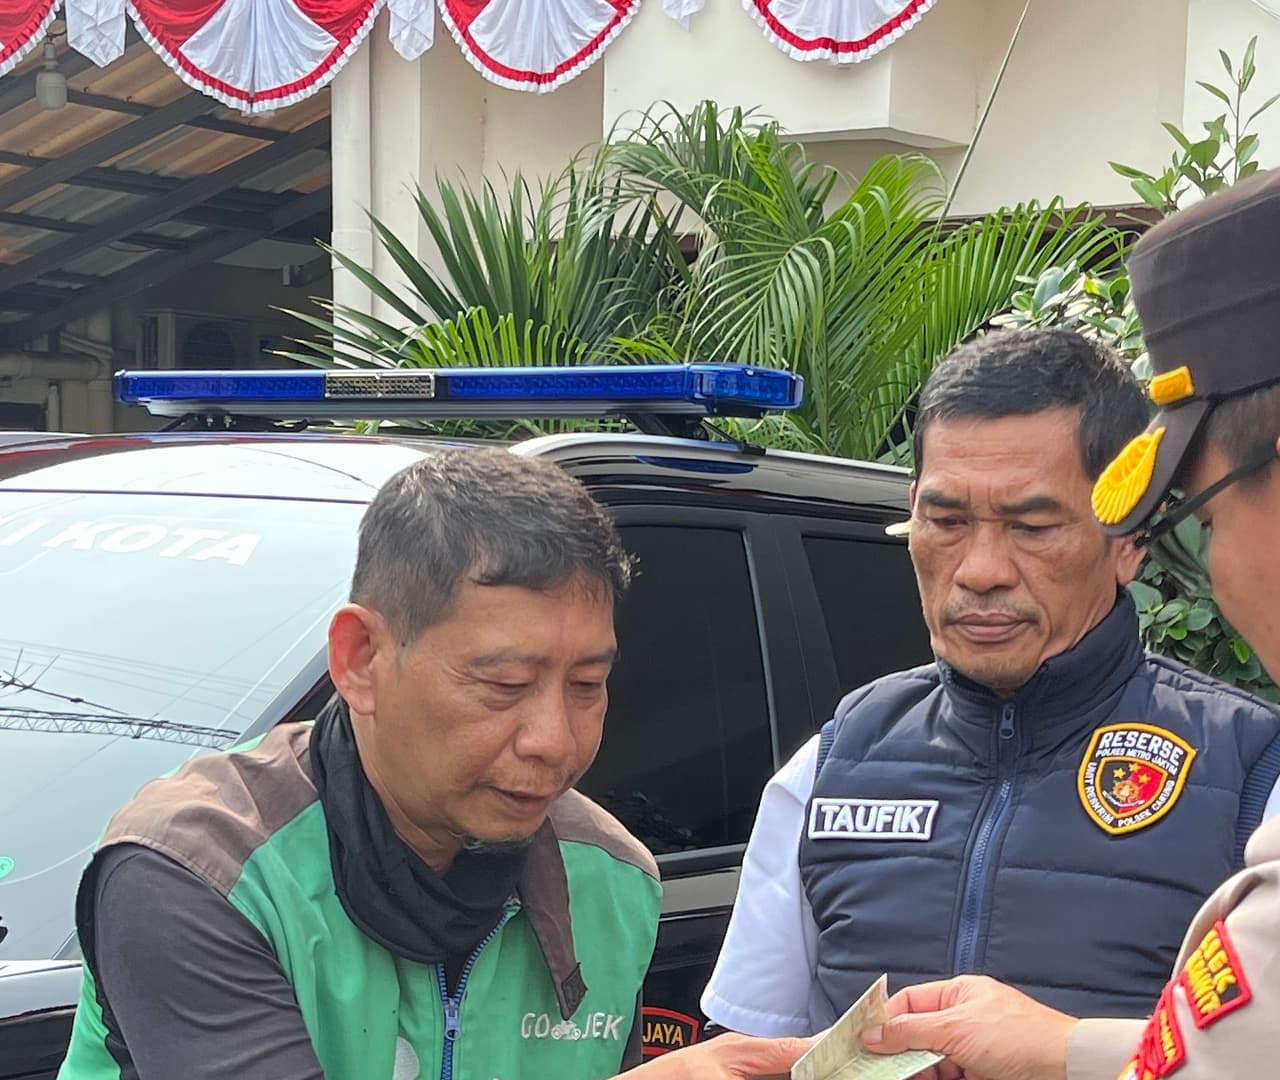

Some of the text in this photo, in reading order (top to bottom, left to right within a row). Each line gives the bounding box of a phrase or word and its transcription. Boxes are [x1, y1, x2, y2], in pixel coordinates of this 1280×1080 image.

[40, 520, 264, 568] KOTA
[1095, 747, 1126, 758] POLRES
[1125, 748, 1152, 761] METRO
[1098, 730, 1184, 767] RESERSE
[1084, 761, 1115, 825] UNIT RESKRIM
[820, 804, 924, 833] TAUFIK
[642, 1022, 685, 1047] JAYA
